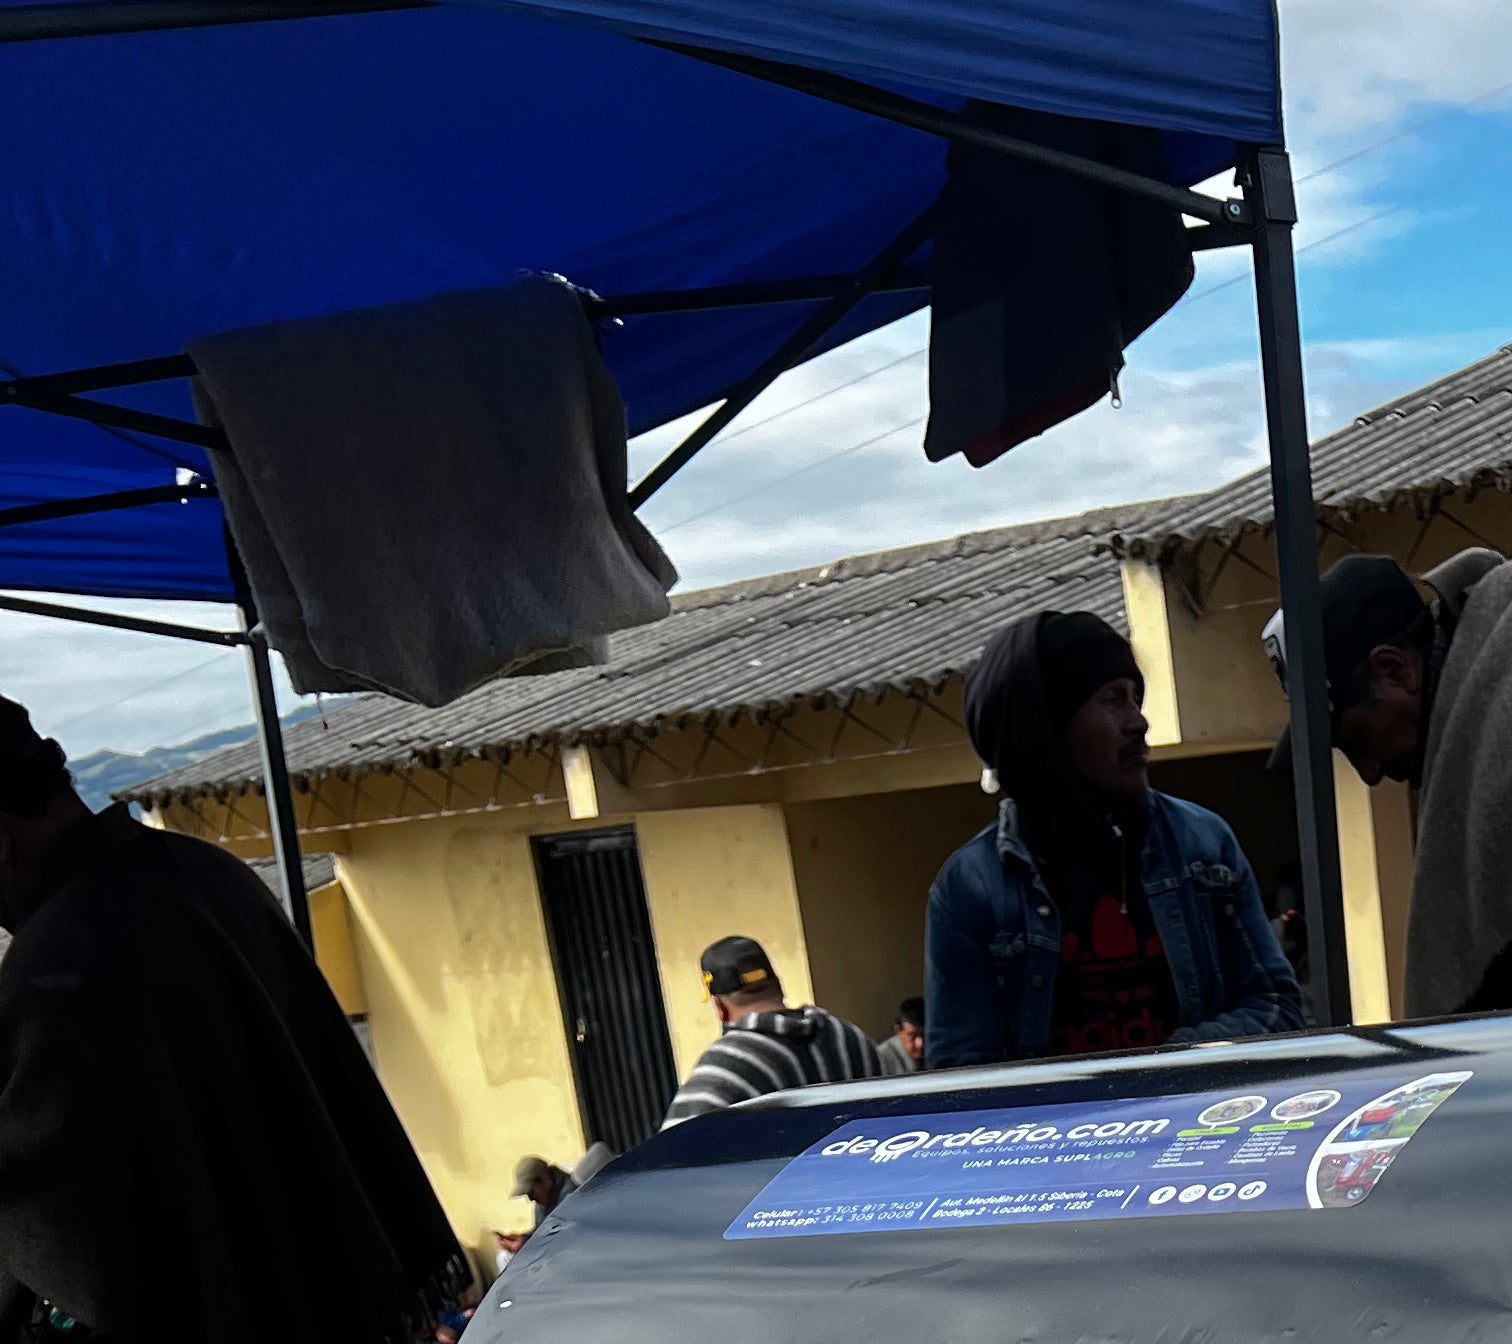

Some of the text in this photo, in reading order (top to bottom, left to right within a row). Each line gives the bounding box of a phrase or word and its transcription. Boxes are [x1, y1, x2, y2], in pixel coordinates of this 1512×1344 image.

[962, 1160, 993, 1169] UNA
[997, 1156, 1050, 1167] MARCA
[1048, 1190, 1089, 1201] Siberia
[1096, 1188, 1125, 1199] Cota
[932, 1207, 975, 1218] Bodega
[992, 1203, 1038, 1215] Locales
[1063, 1199, 1096, 1211] 1225
